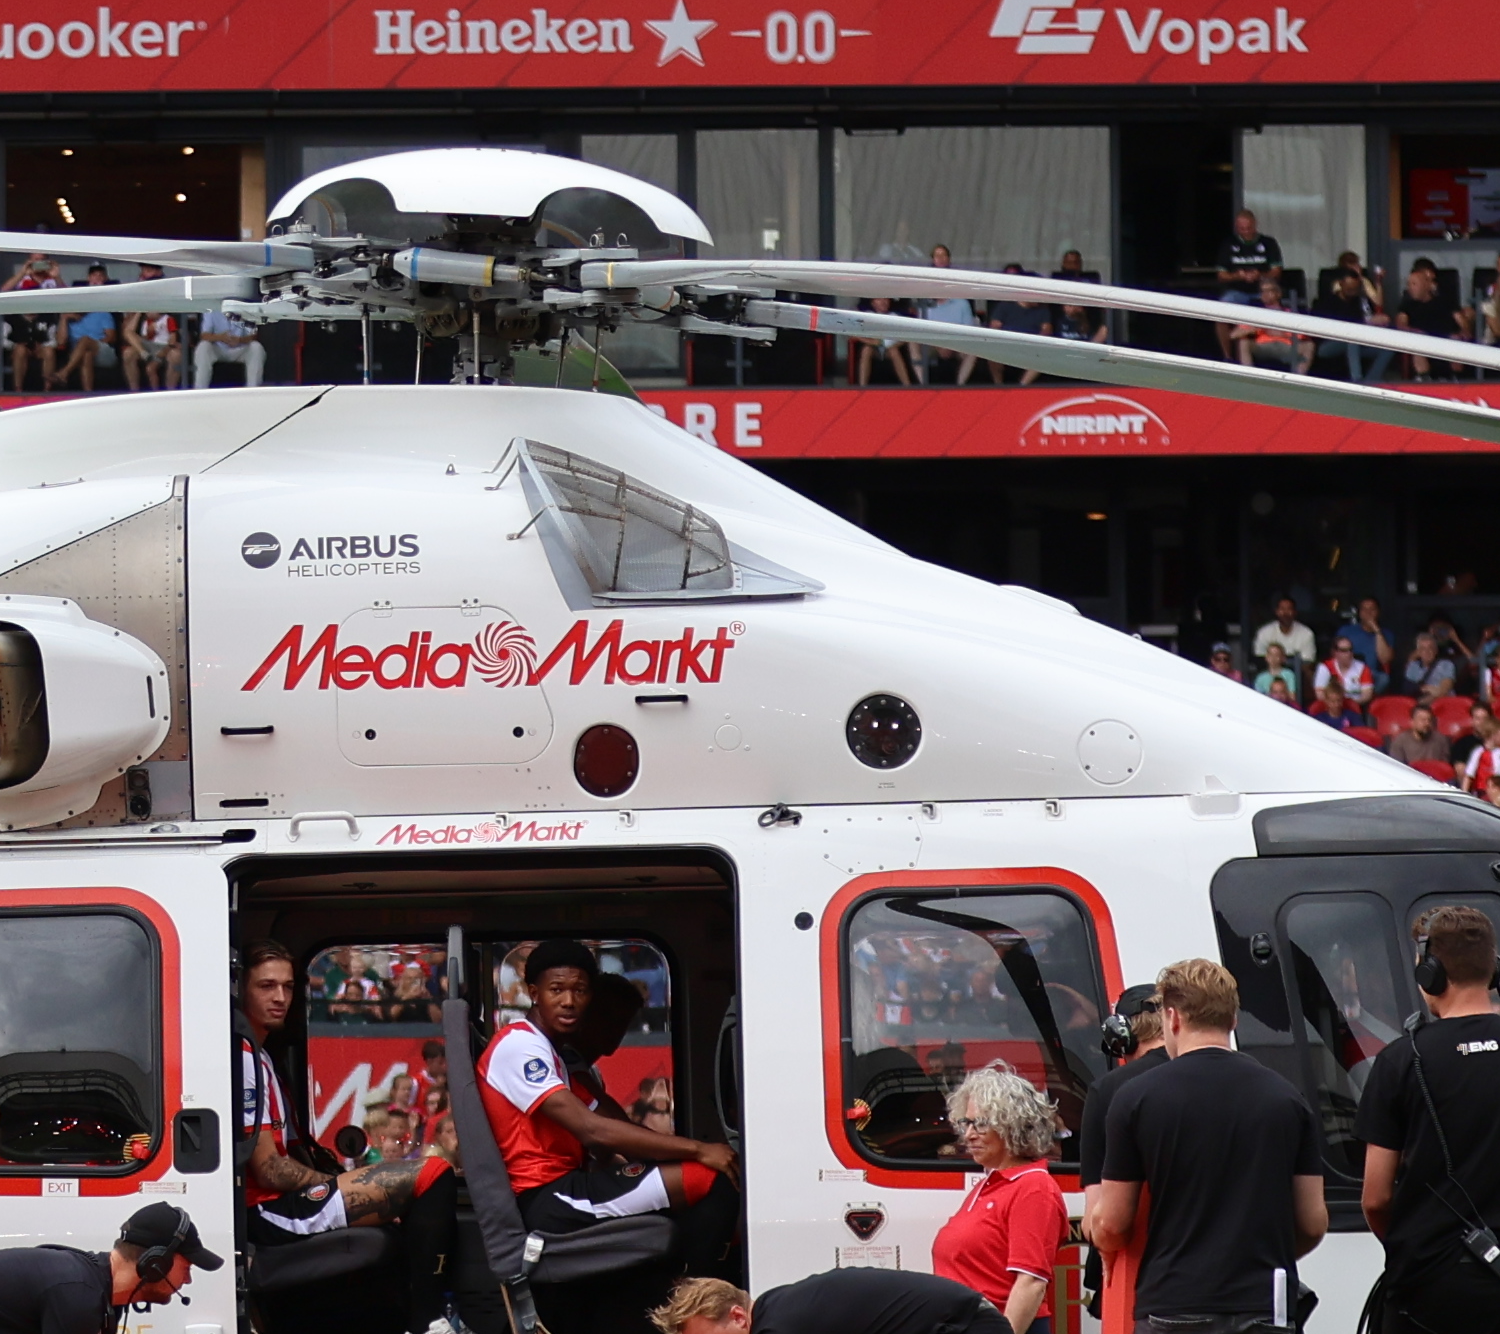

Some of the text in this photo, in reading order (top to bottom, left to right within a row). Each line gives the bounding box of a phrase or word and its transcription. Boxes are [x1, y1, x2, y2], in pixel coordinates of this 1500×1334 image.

[373, 8, 635, 56] Heineken
[1115, 6, 1310, 67] Vopak
[1041, 414, 1148, 435] NIRINT
[287, 533, 420, 562] AIRBUS
[287, 561, 421, 578] HELICOPTERS
[240, 624, 474, 692] Media
[375, 823, 473, 846] Media
[1469, 1040, 1499, 1053] EMG
[48, 1182, 72, 1193] EXIT
